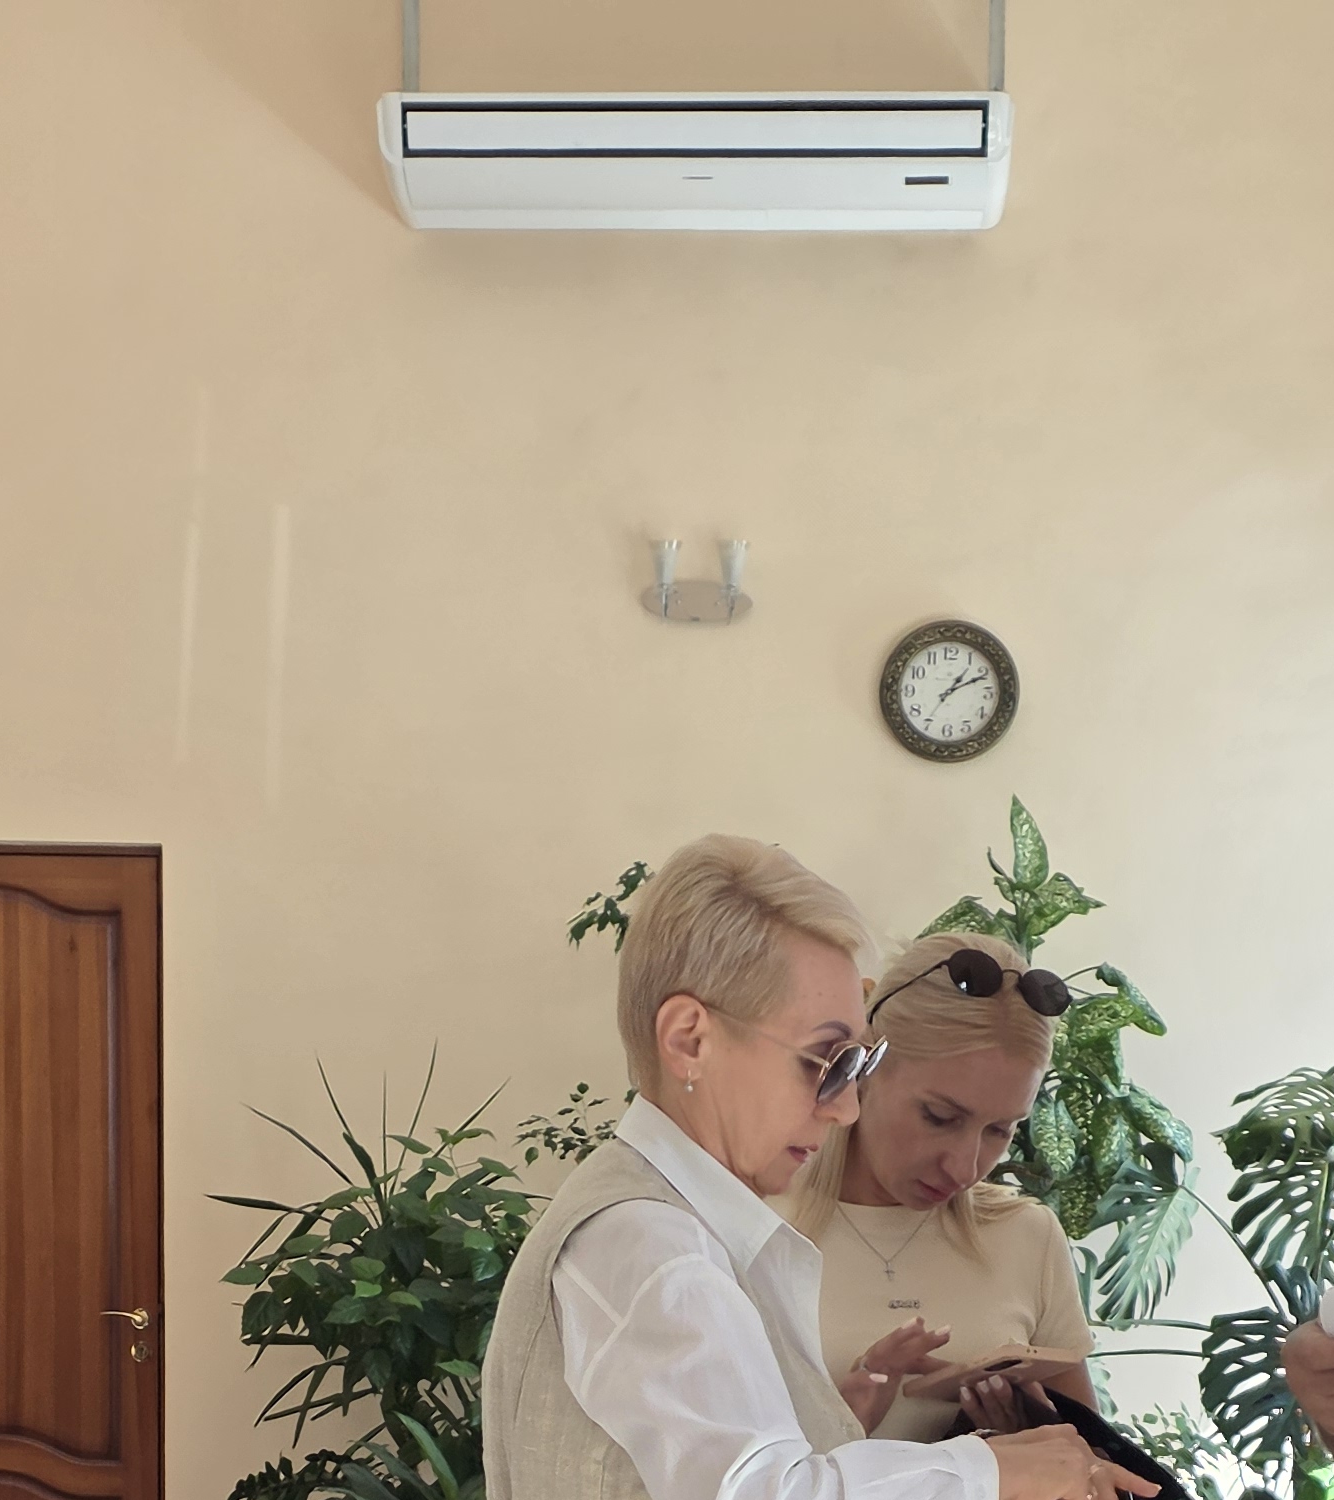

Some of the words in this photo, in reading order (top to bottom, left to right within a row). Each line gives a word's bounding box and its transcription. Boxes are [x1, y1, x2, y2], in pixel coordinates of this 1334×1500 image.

[926, 651, 937, 666] 11
[943, 646, 960, 661] 12
[911, 666, 926, 680] 10
[903, 684, 915, 698] 9
[909, 703, 921, 717] 8
[975, 705, 987, 720] 4
[923, 718, 934, 731] 7
[941, 724, 953, 738] 6
[960, 719, 972, 733] 5
